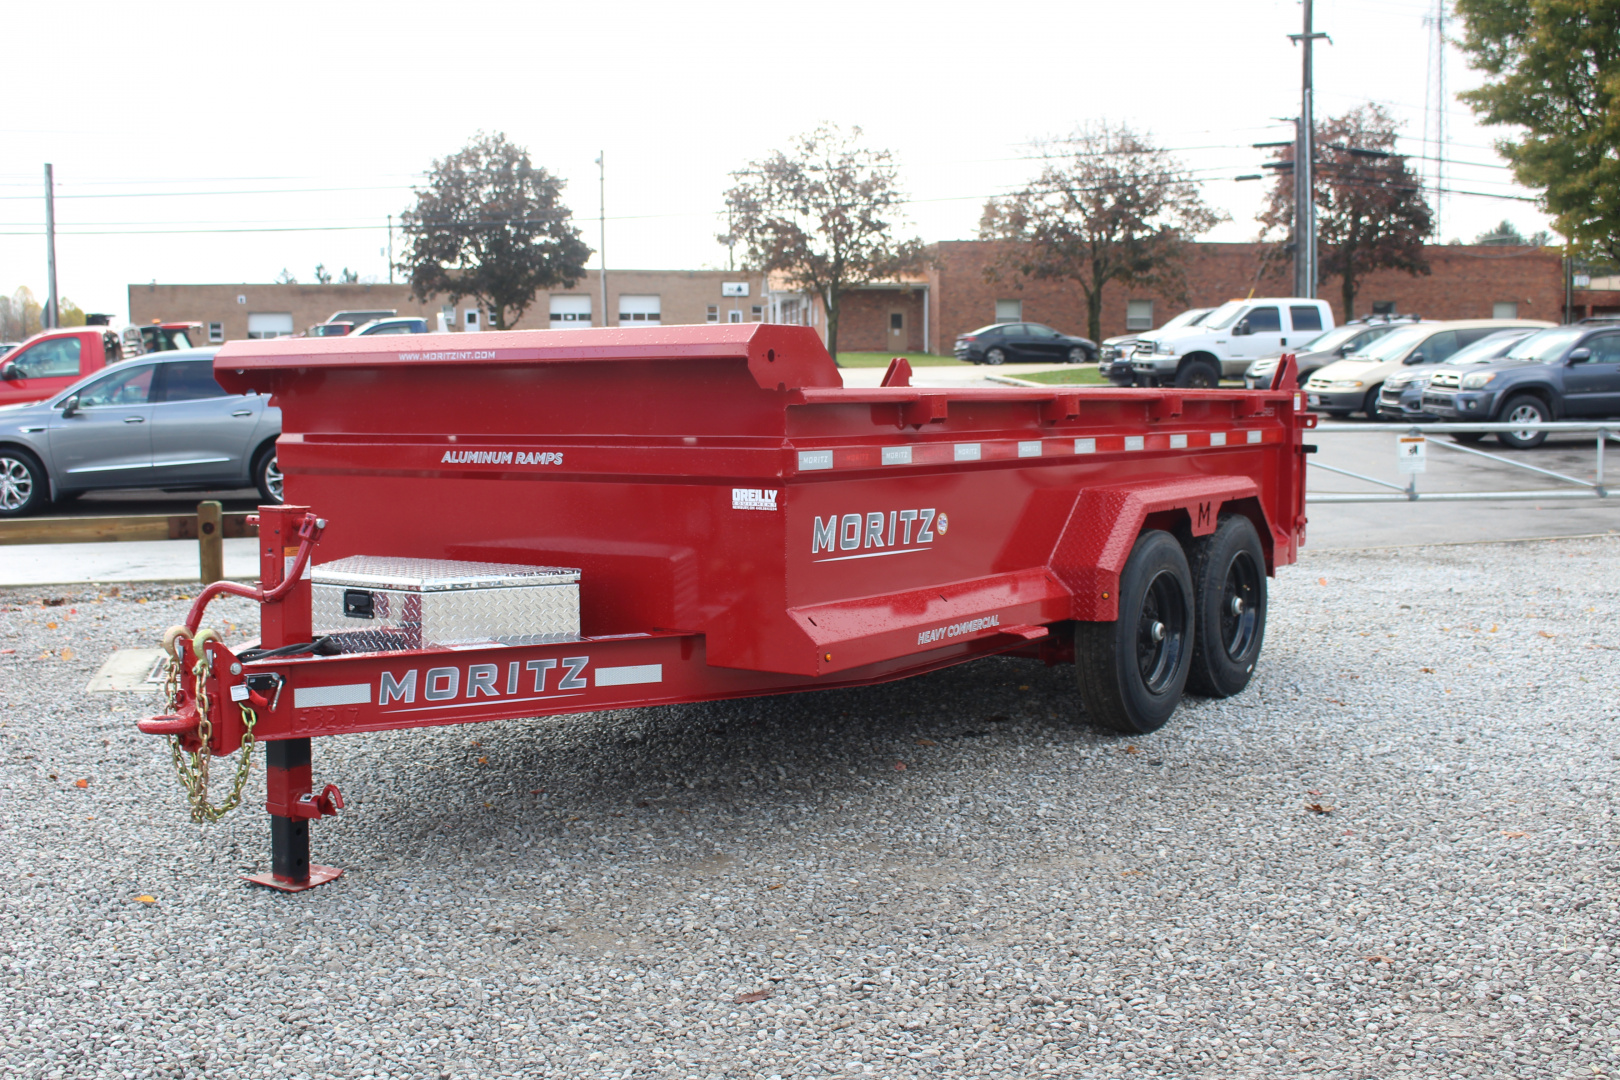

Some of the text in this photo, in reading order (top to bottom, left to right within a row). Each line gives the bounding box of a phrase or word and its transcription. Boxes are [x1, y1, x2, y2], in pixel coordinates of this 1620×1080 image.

[399, 351, 496, 361] WWW.MORITZINT.COM
[441, 451, 564, 466] ALUMINUM RAMPS
[803, 455, 829, 464] MORITZ
[886, 451, 908, 459] MORITZ
[1198, 501, 1211, 528] M
[812, 508, 936, 554] MORITZ
[917, 614, 1000, 645] HEAVY COMMERCIAL
[378, 656, 590, 706] MORITZ
